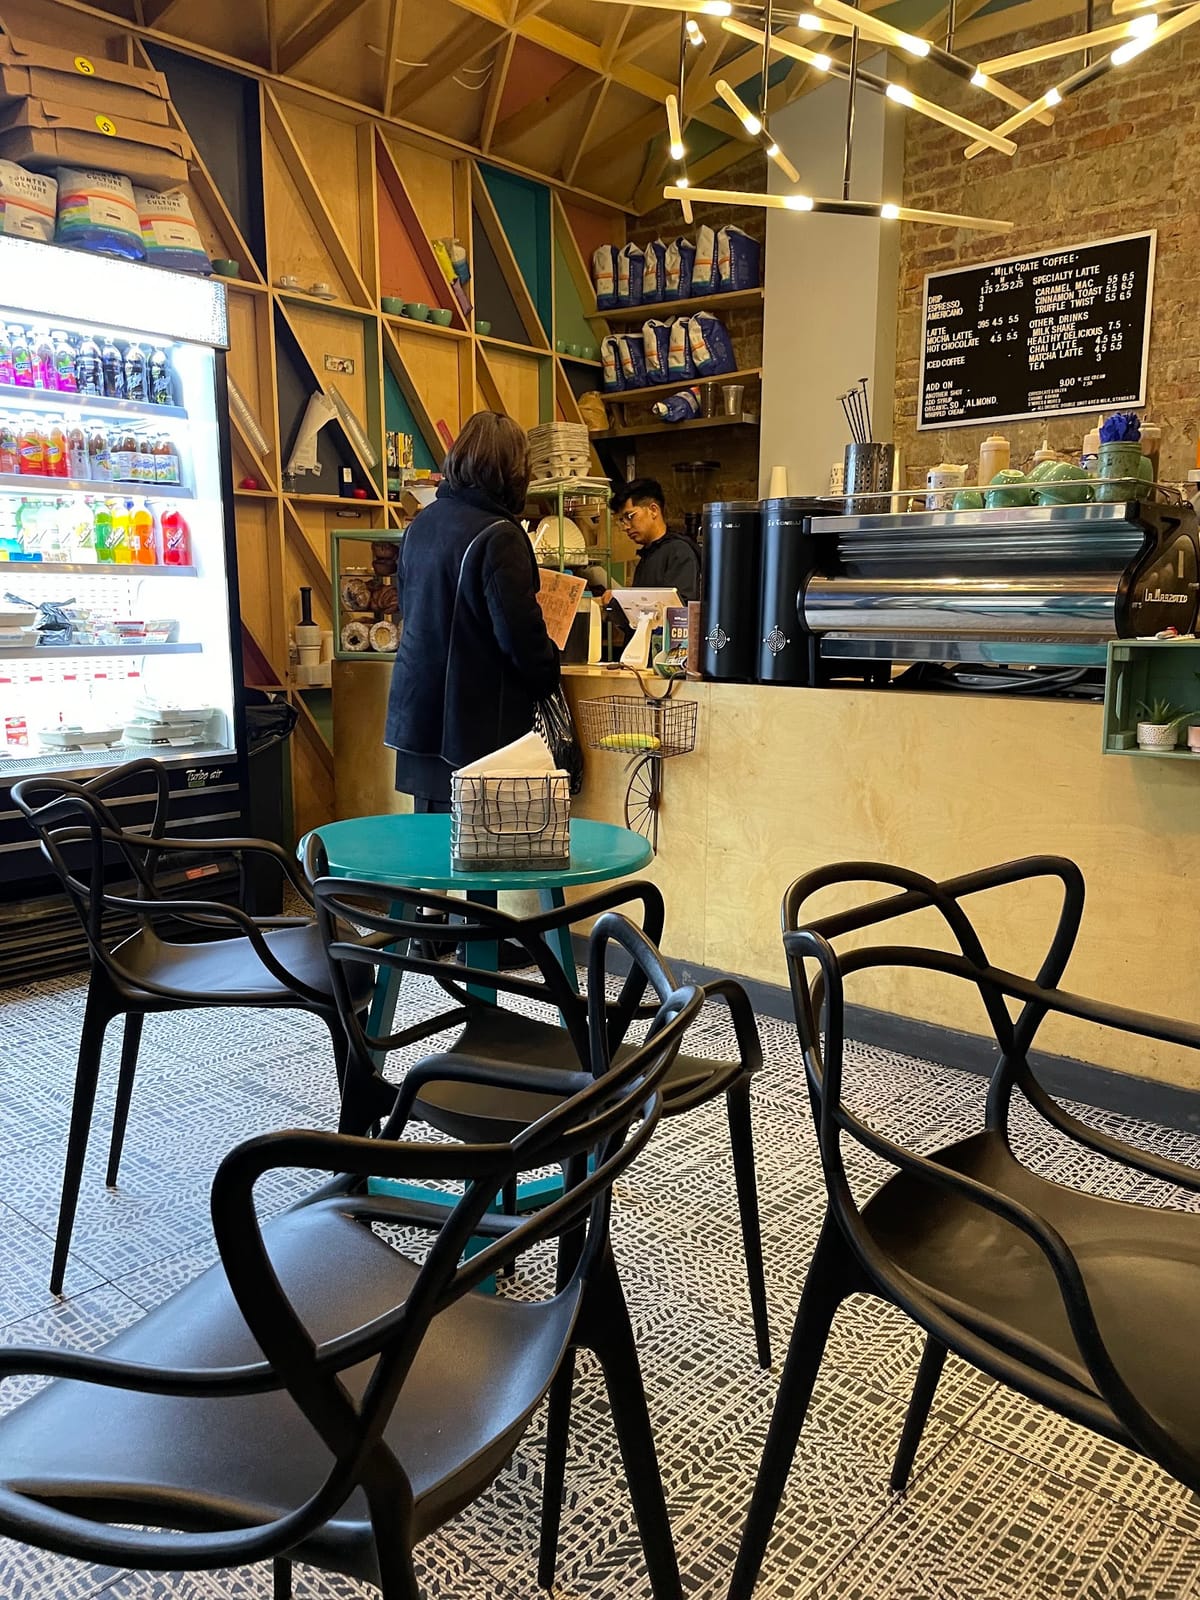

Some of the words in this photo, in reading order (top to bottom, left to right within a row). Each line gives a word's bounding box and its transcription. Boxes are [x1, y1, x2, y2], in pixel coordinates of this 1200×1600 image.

[80, 62, 90, 72] 5
[102, 122, 110, 132] 5
[15, 182, 46, 194] ULTURE
[147, 199, 181, 207] CULTURE
[1014, 261, 1039, 272] CRATE
[1042, 254, 1074, 266] COFFEE
[1033, 270, 1073, 285] SPECIALTY
[1076, 265, 1100, 277] LATTE
[1036, 283, 1071, 296] CARAMEL
[1075, 279, 1094, 290] MAC
[928, 295, 943, 304] DRIP
[1035, 291, 1074, 305] CINNAMON
[1078, 286, 1103, 298] TOAST
[928, 300, 960, 312] ESPRESSO
[980, 296, 984, 304] 3
[1035, 301, 1066, 314] TRUFFLE
[1071, 296, 1095, 308] TWIST
[928, 307, 964, 320] AMERICANO
[978, 304, 983, 312] 3
[1029, 317, 1054, 328] OTHER
[1059, 312, 1088, 324] DRINKS
[927, 327, 946, 337] LATTE
[1032, 326, 1050, 337] MILK
[1051, 322, 1076, 334] SHAKE
[1108, 320, 1120, 330] 7.5
[927, 335, 950, 345] MOCHA
[952, 330, 973, 341] LATTE
[1027, 332, 1061, 346] HEALTHY
[1064, 327, 1103, 340] DELICIOUS
[927, 344, 940, 353] HOT
[941, 338, 980, 351] CHOCOLATE
[1030, 344, 1048, 354] CHAI
[1052, 339, 1077, 351] LATTE
[1029, 352, 1056, 362] MATCHA
[1060, 347, 1084, 358] LATTE
[927, 359, 940, 369] ICED
[942, 356, 965, 367] COFFEE
[1029, 362, 1044, 371] TEA
[926, 382, 940, 392] ADD
[943, 381, 953, 389] ON
[1060, 378, 1075, 387] 9.00
[672, 628, 688, 638] CBD
[186, 769, 208, 781] Turbo
[210, 769, 223, 779] air
